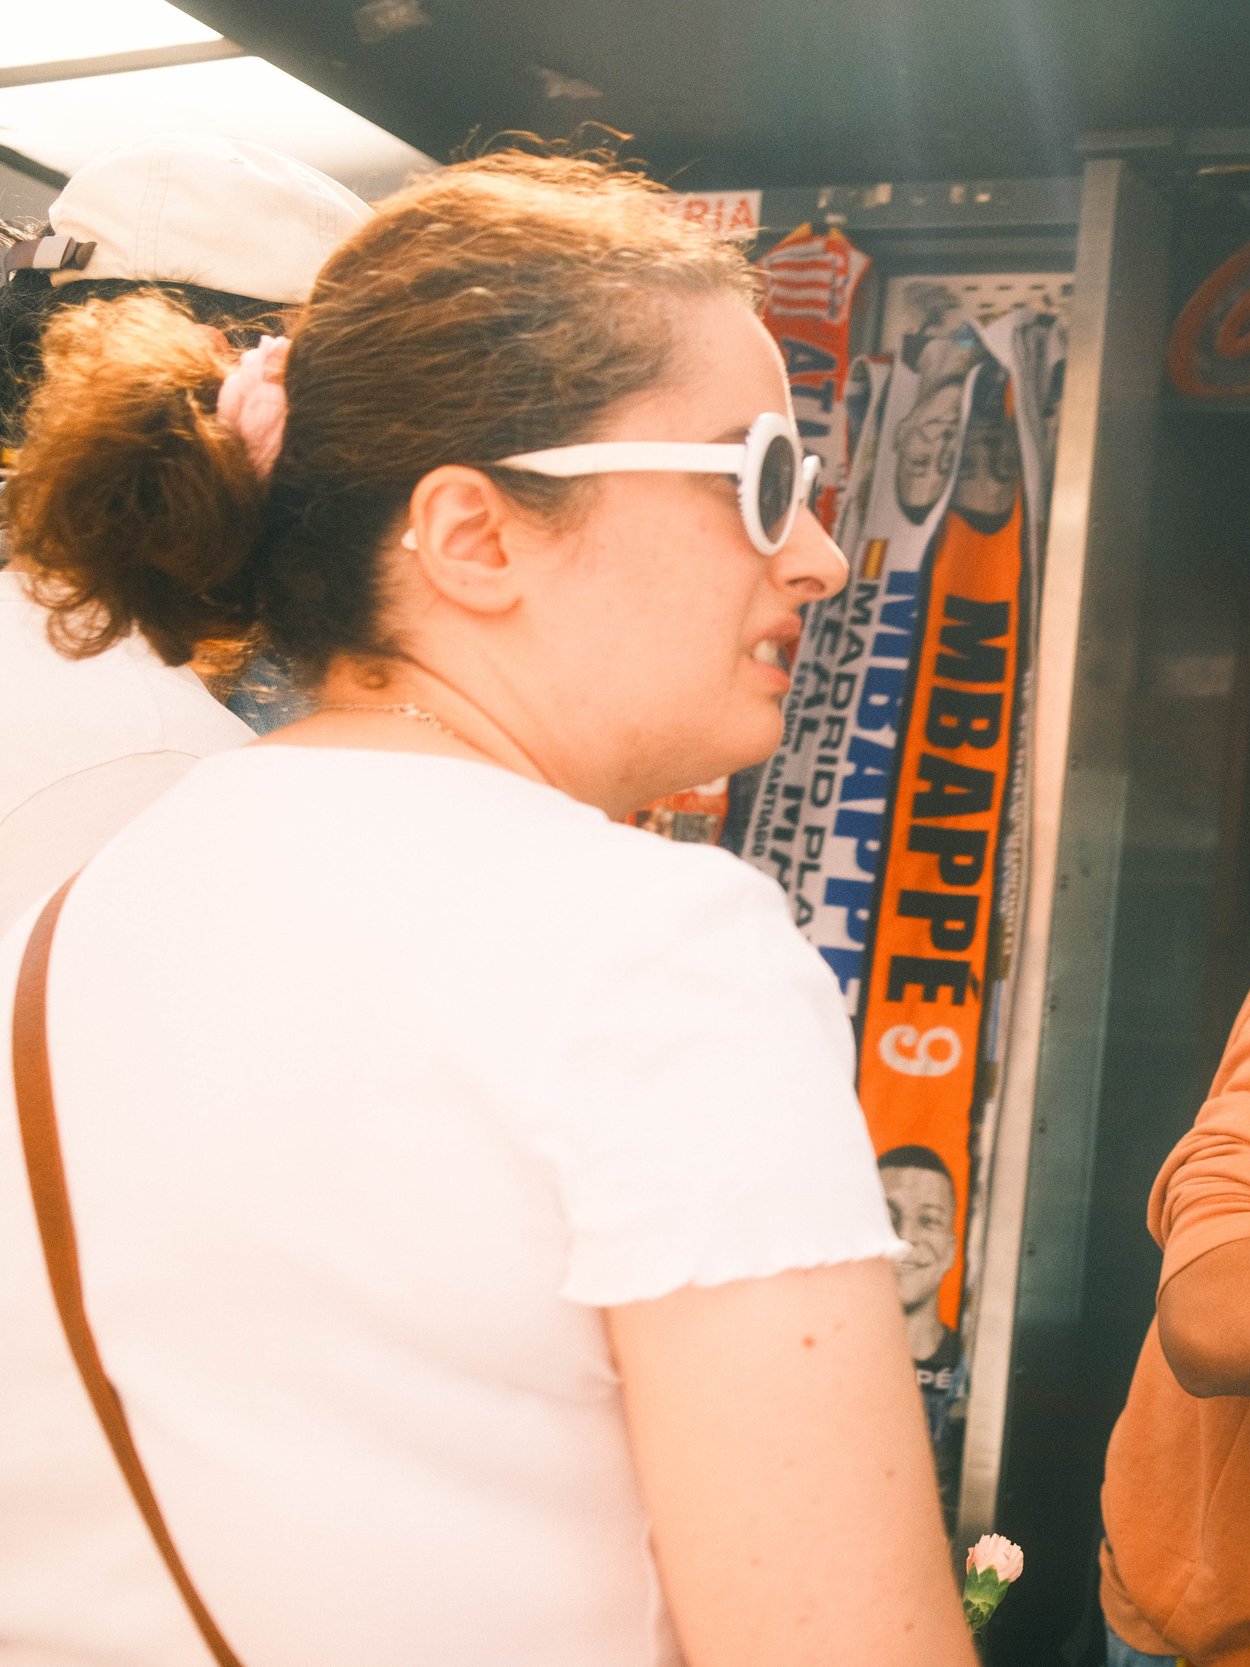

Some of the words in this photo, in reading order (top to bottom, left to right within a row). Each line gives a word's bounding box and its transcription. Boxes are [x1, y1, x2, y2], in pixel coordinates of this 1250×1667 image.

[683, 197, 753, 232] RIA
[808, 583, 882, 810] MADRID
[752, 753, 788, 858] SANTIAGO
[818, 571, 922, 996] MBAPP
[886, 594, 1011, 1006] MBAPPÉ
[796, 825, 827, 940] PLA
[877, 1023, 964, 1078] 9
[915, 1367, 953, 1390] PÉ
